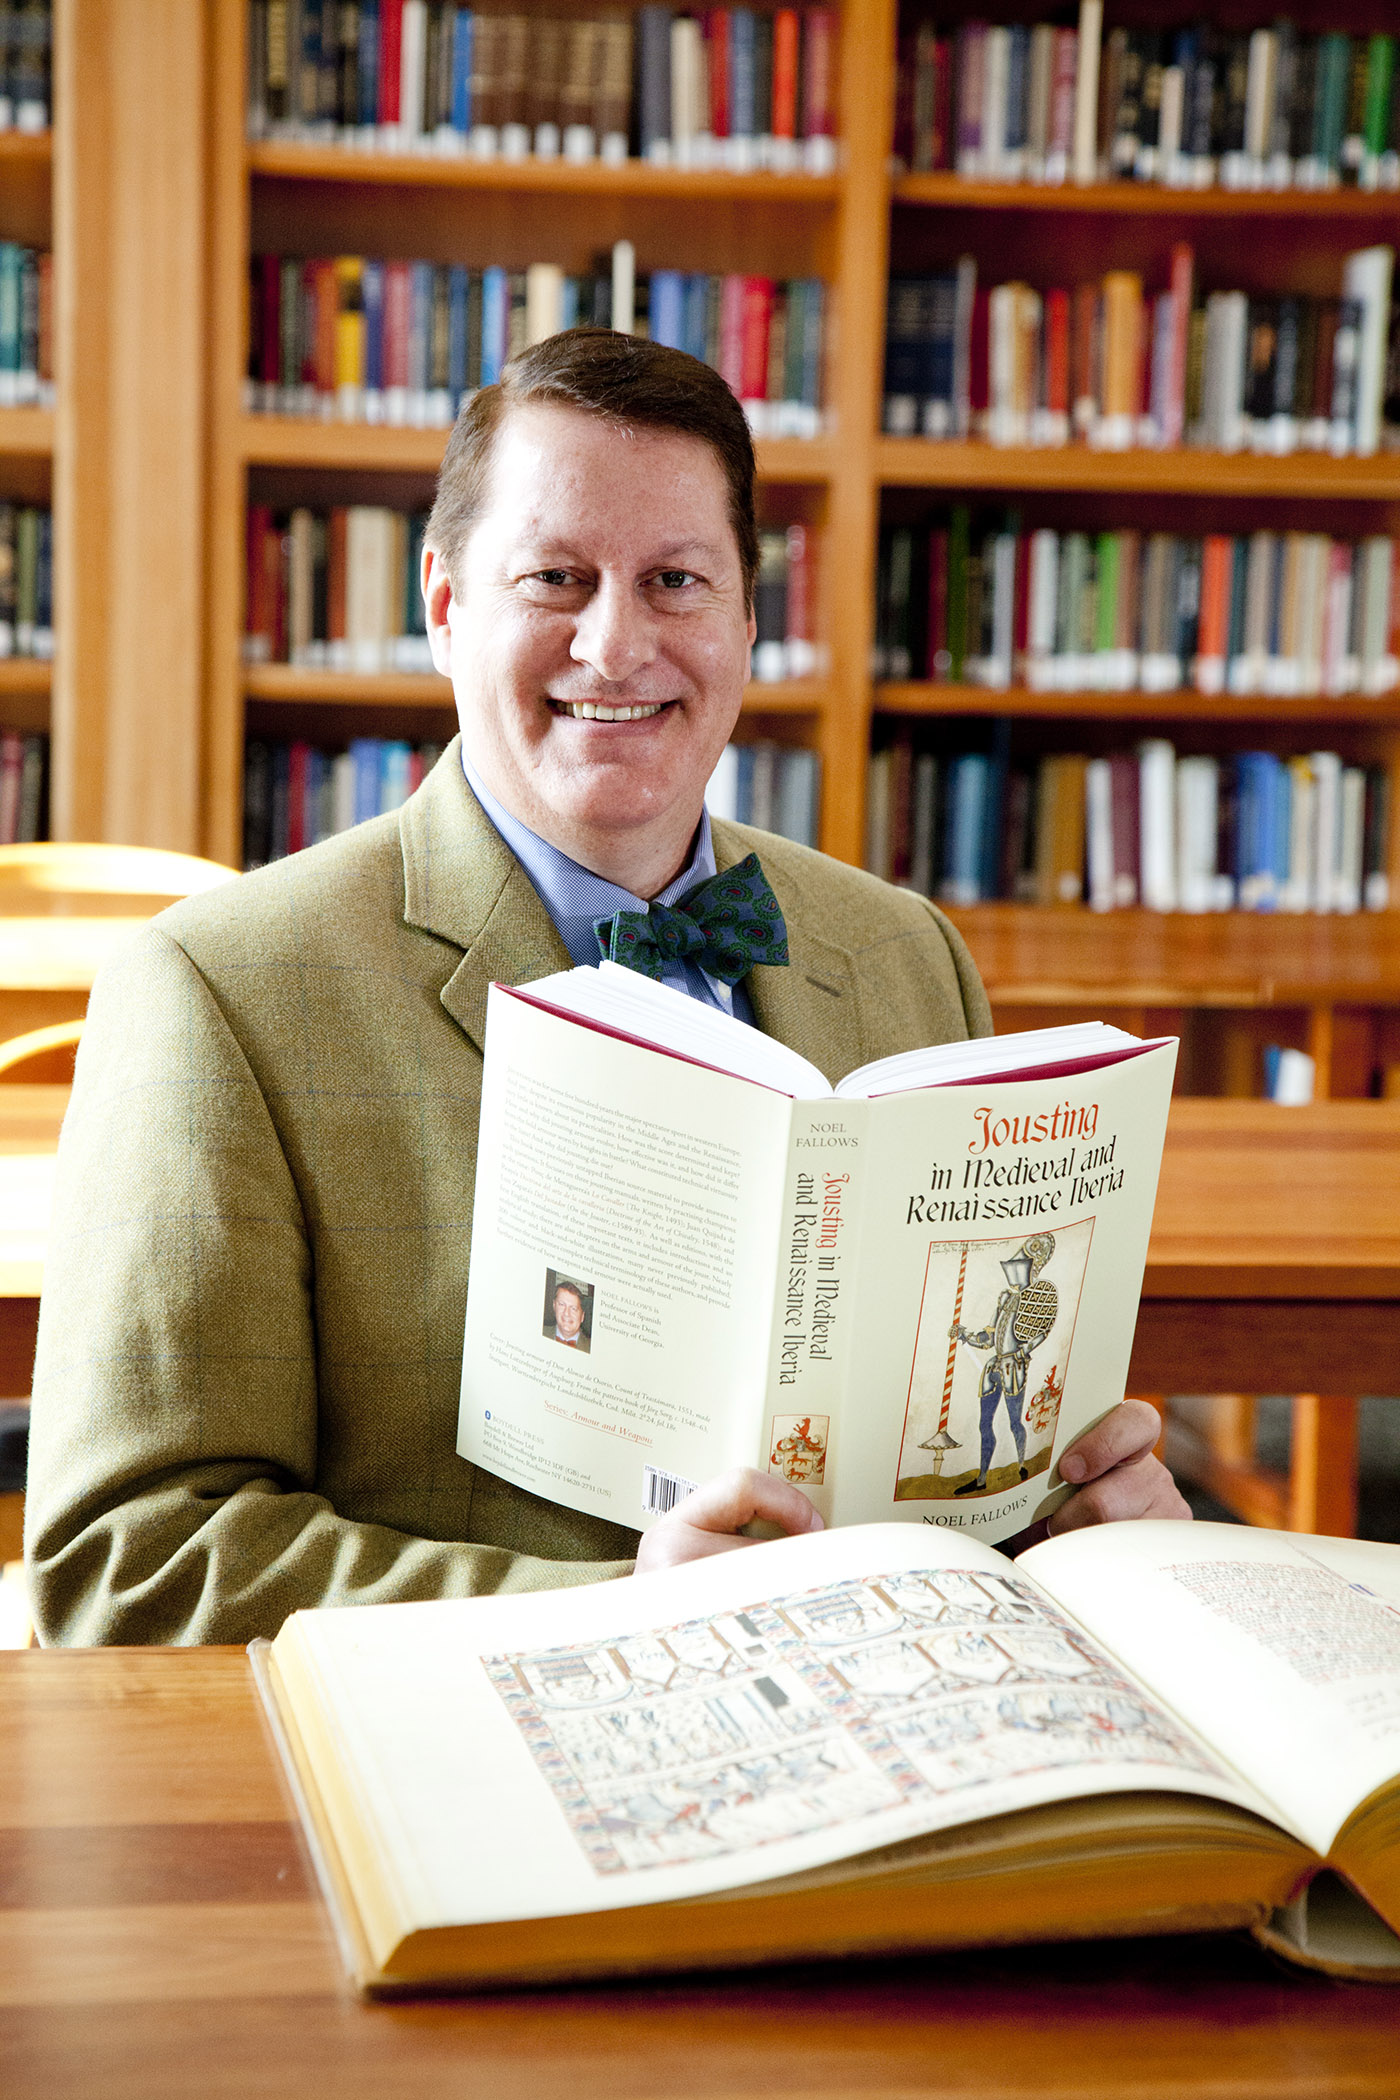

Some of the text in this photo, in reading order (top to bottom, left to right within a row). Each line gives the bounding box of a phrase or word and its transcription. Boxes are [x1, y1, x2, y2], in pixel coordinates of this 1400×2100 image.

[796, 1137, 858, 1147] FALLOWS
[810, 1123, 846, 1133] NOEL
[968, 1101, 1099, 1154] Jousting
[931, 1135, 1116, 1190] in Medieval and
[907, 1167, 1124, 1224] Renaissance Iberia
[779, 1173, 818, 1385] and Renaissance Iberia
[809, 1172, 850, 1360] Jousting in Medieval
[544, 1399, 652, 1444] Series: Armour and Weapons
[923, 1496, 1027, 1526] NOEL FALLOWS
